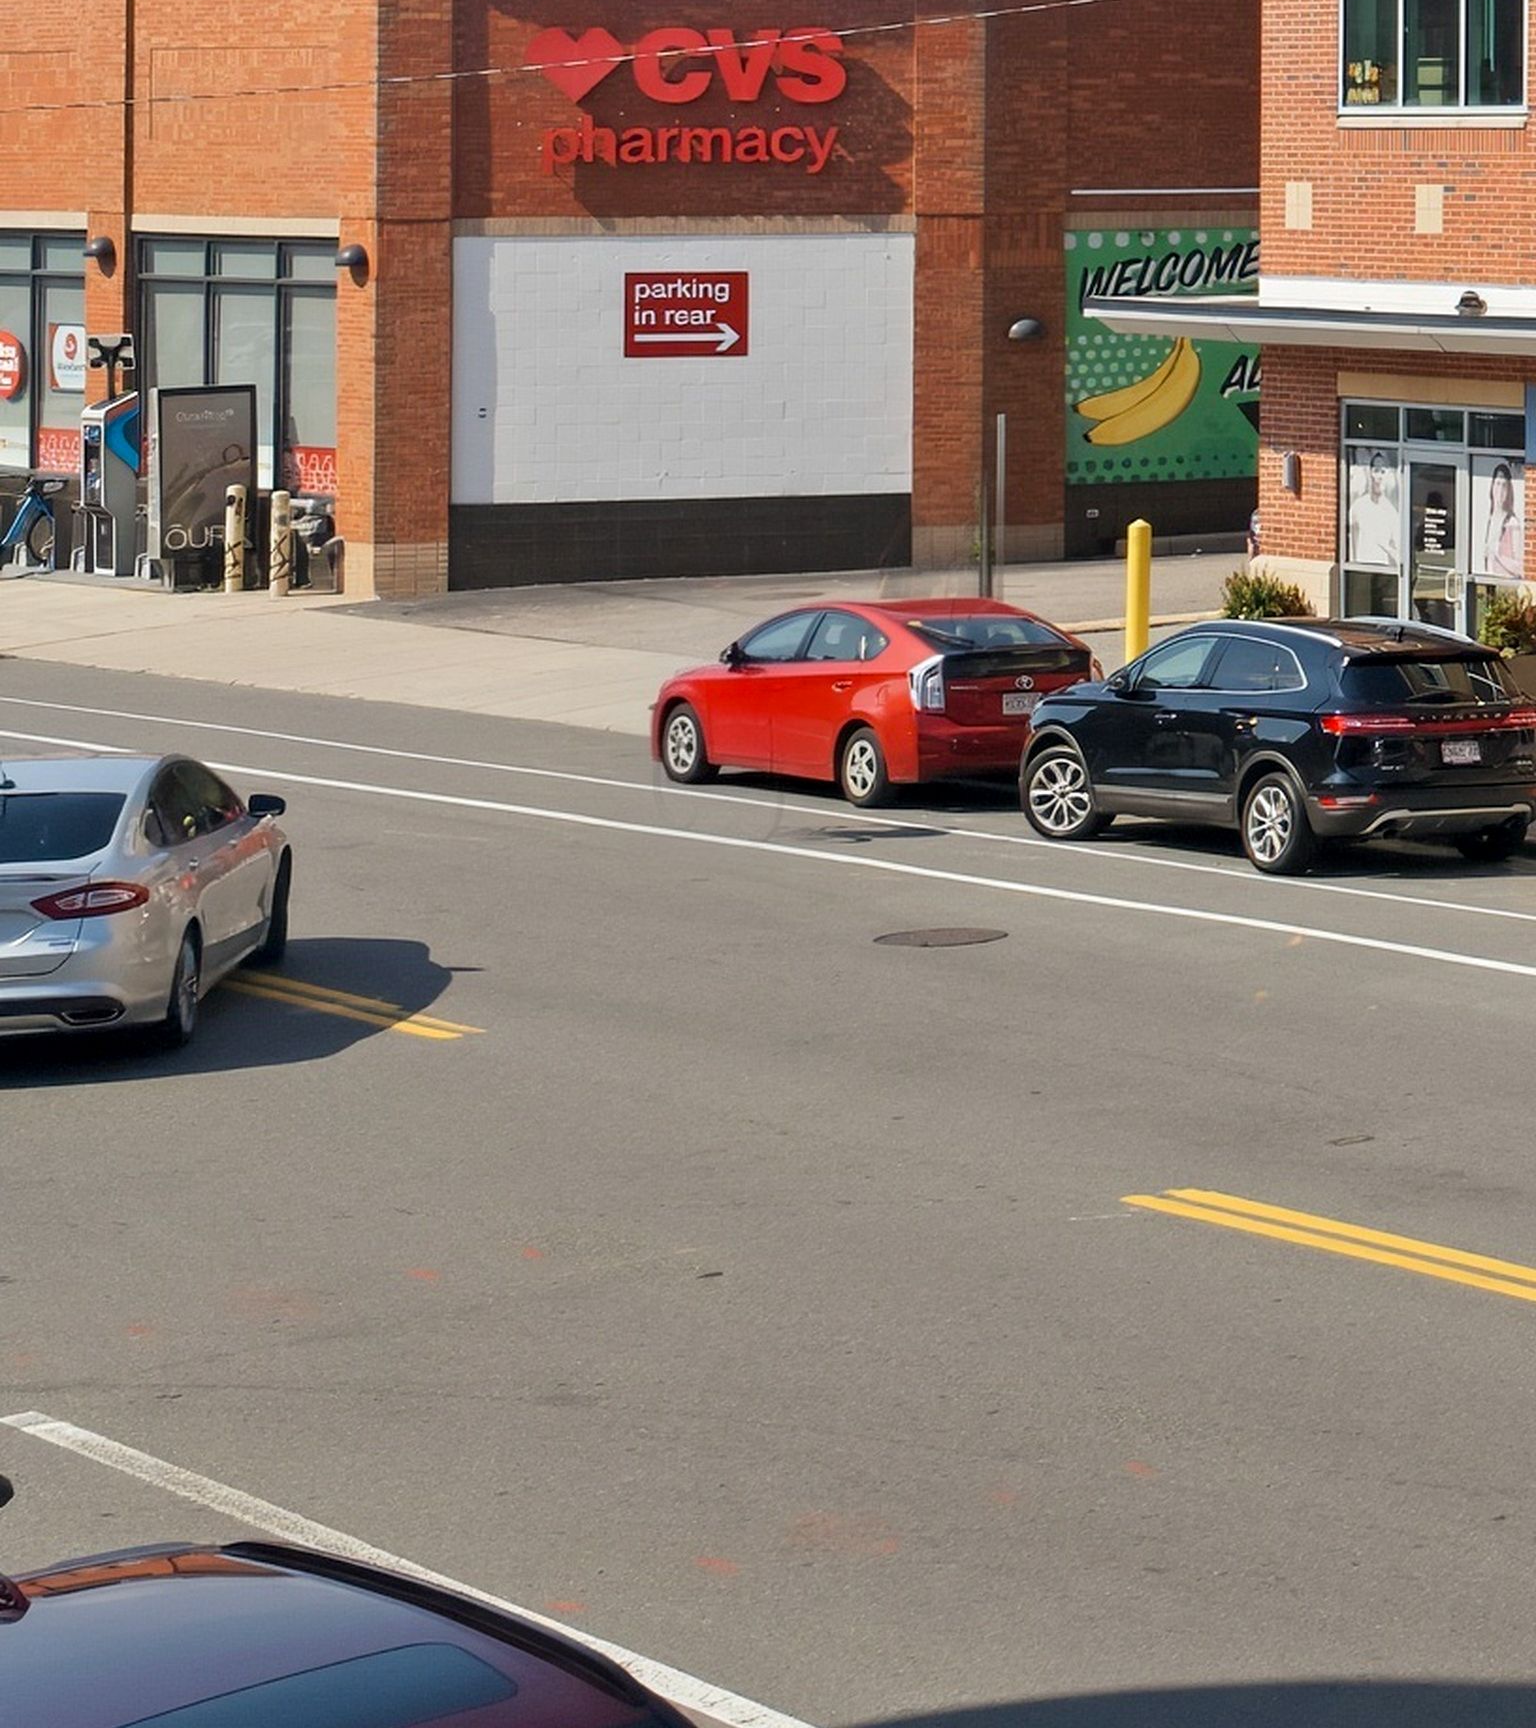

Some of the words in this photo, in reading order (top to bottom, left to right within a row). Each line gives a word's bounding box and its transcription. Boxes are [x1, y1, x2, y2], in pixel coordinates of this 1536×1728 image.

[633, 27, 847, 104] CVS
[541, 115, 839, 174] pharmacy
[634, 278, 730, 303] parking
[1081, 240, 1260, 300] WELCOME
[634, 306, 656, 325] in
[664, 309, 716, 325] rear
